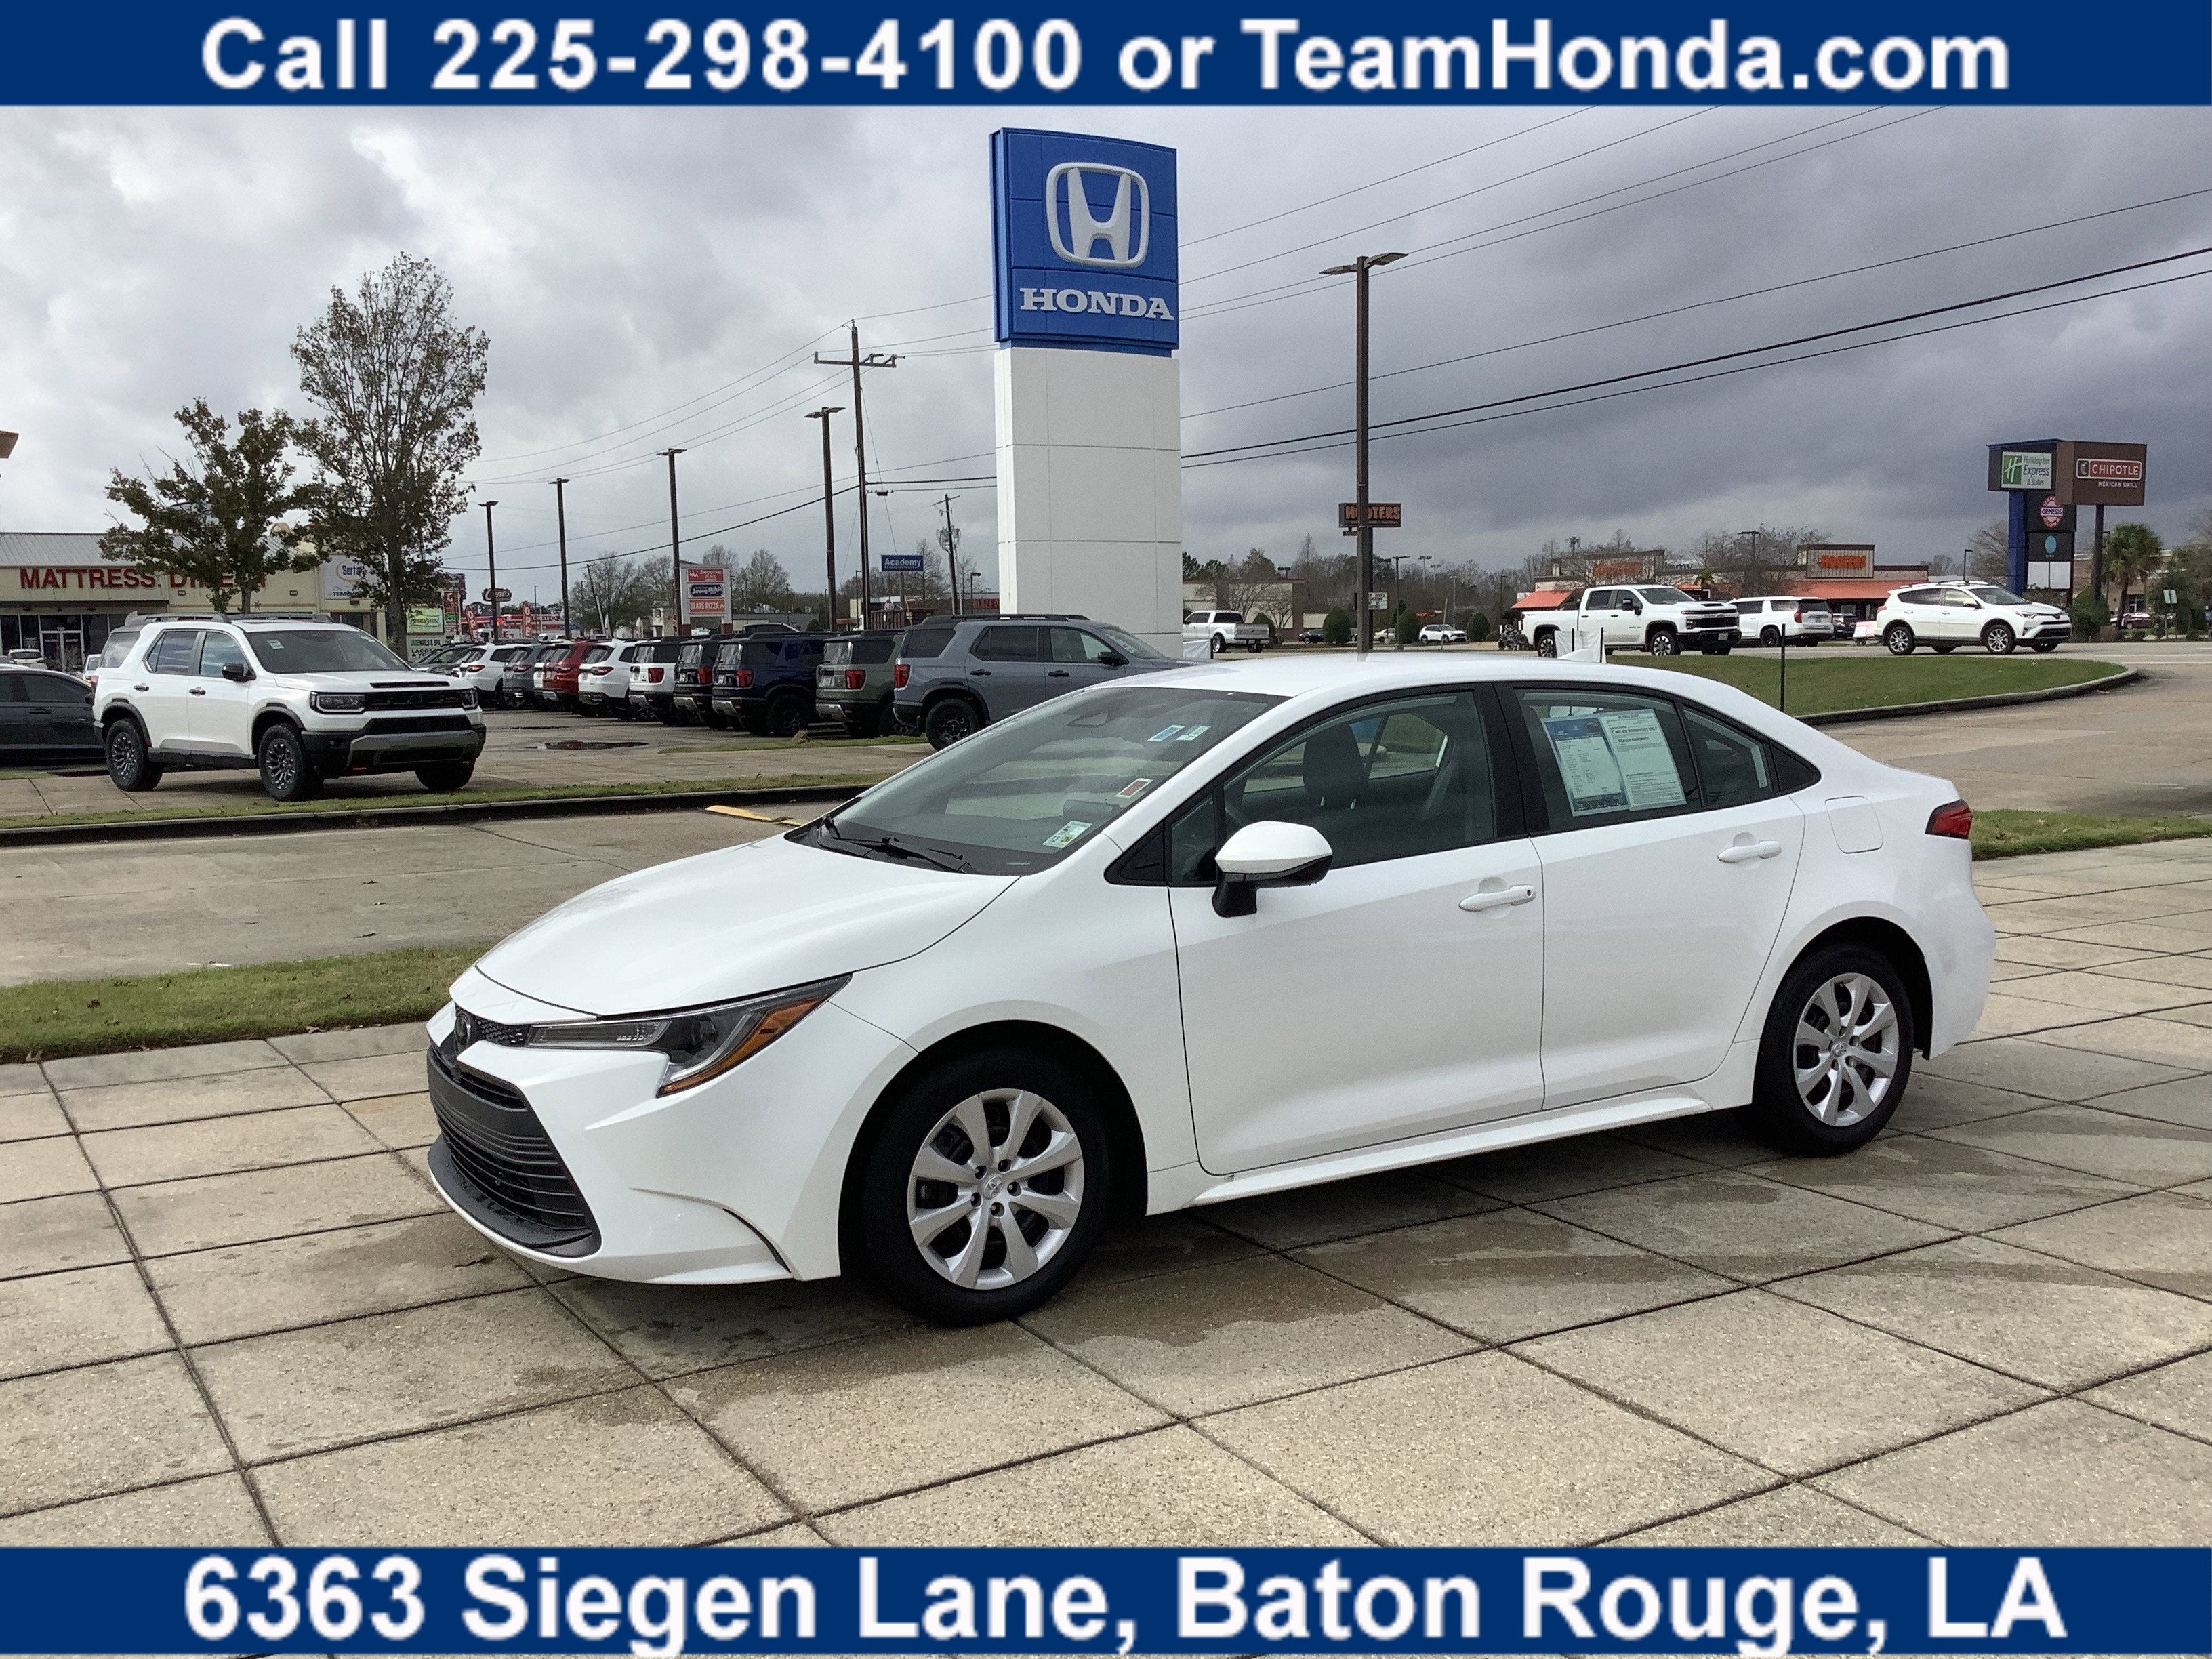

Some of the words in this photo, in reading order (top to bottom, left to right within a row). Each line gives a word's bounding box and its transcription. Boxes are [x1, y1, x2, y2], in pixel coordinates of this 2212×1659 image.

[1019, 287, 1174, 321] HONDA
[2023, 464, 2050, 478] Express
[2091, 464, 2139, 476] CHIPOTLE
[884, 558, 922, 569] Academy
[20, 567, 157, 589] MATTRESS
